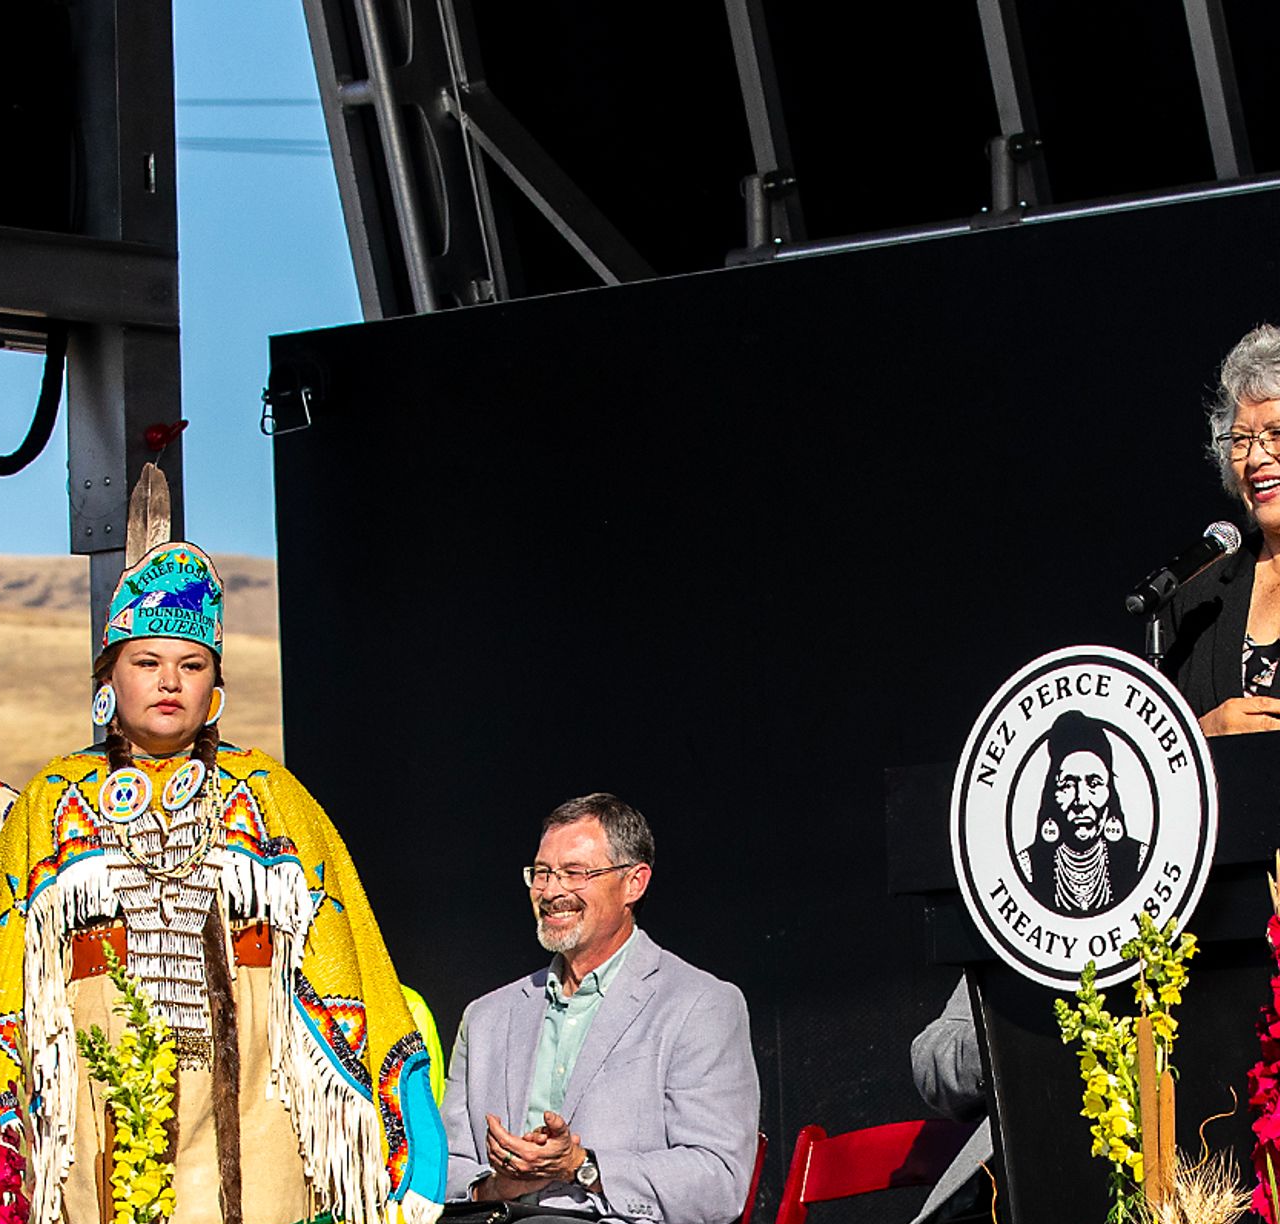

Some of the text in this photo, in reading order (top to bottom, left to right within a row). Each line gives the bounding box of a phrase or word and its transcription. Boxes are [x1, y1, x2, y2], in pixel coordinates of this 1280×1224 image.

[136, 562, 174, 591] CHIEF
[138, 606, 216, 629] FOUNDATION
[148, 618, 207, 639] QUEEN
[976, 672, 1188, 788] NEZ PERCE TRIBE
[989, 861, 1182, 959] TREATY OF 1855
